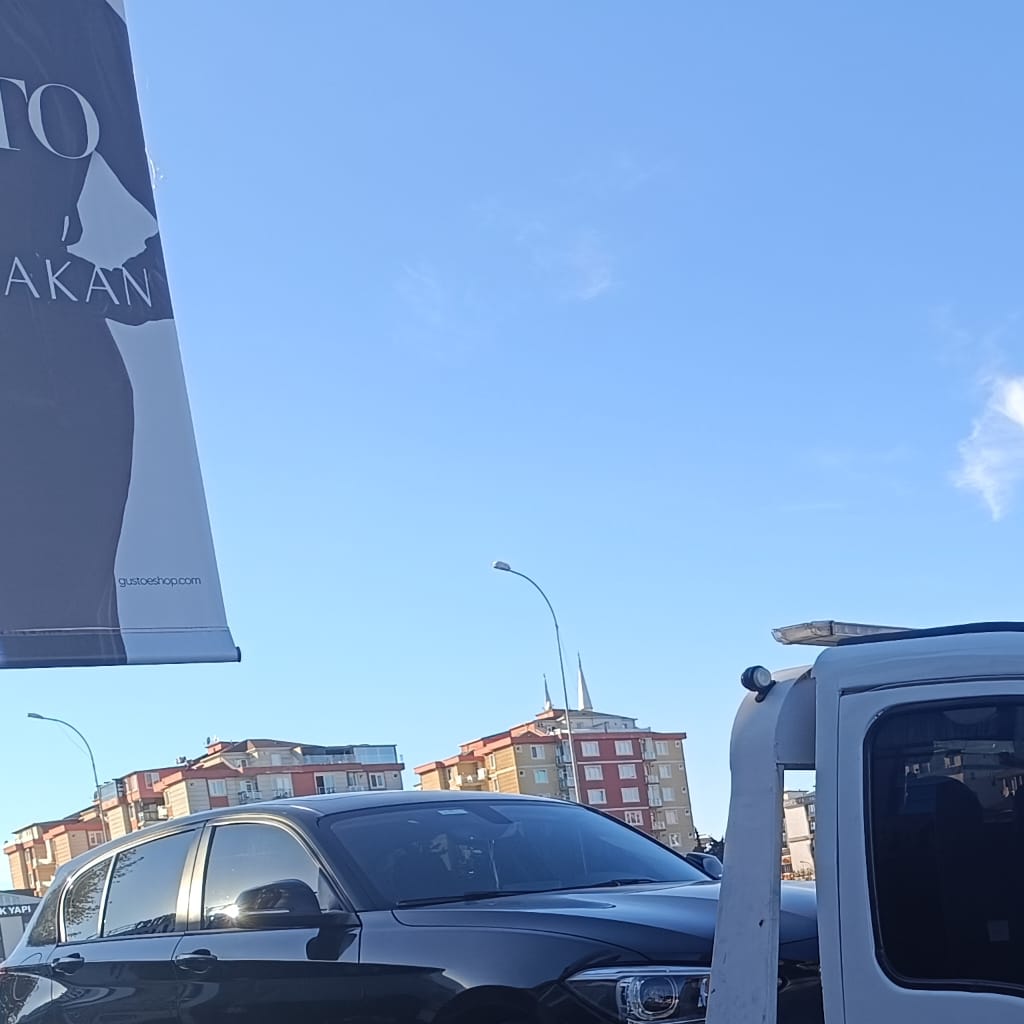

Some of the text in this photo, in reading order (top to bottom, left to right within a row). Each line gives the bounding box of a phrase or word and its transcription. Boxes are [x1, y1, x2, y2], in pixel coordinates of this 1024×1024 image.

[5, 256, 152, 307] AKAN
[118, 576, 202, 588] gustoeshop.com
[7, 905, 31, 915] YAPI
